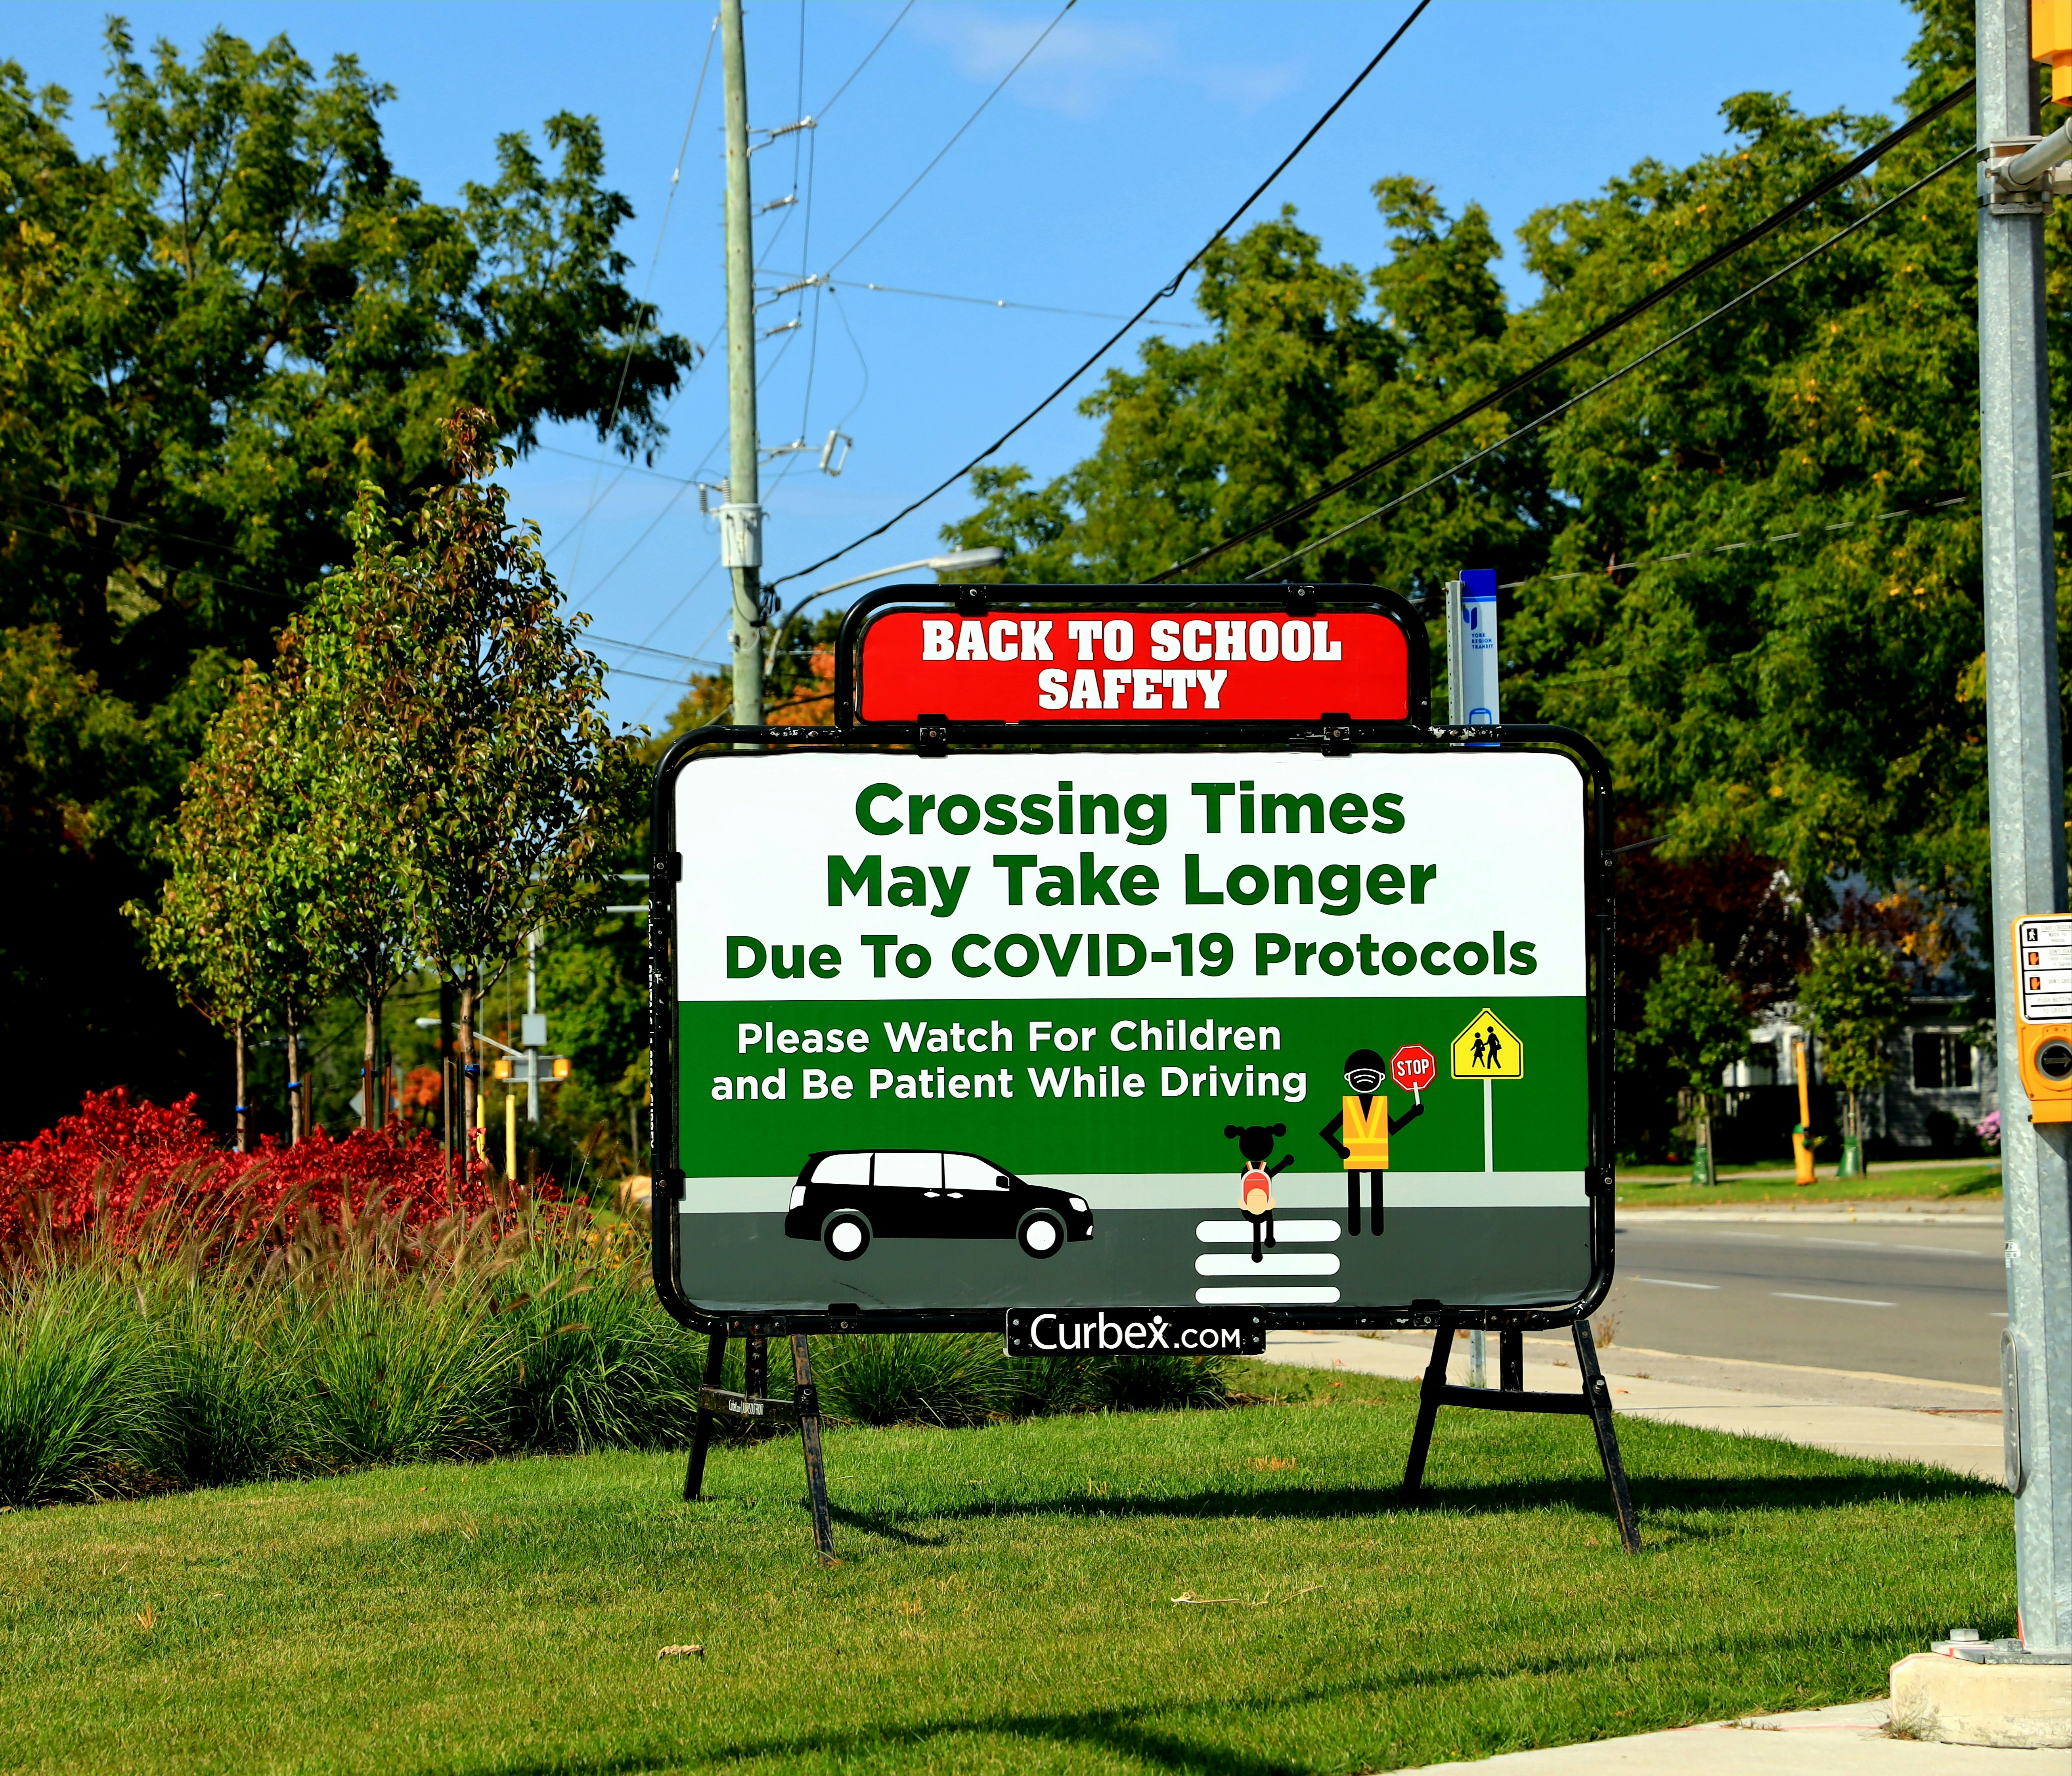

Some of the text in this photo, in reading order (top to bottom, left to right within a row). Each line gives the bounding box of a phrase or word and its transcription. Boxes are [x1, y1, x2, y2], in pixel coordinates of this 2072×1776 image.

[922, 620, 1342, 661] BACK TO SCHOOL
[1038, 668, 1228, 710] SAFETY
[855, 780, 1406, 845] Crossing Times
[827, 852, 1437, 918] May Take Longer
[726, 930, 1537, 979] Due To COVID-19 Protocols
[738, 1019, 1280, 1053] Please Watch For Children
[711, 1065, 1307, 1103] and Be Patient While Driving
[1397, 1059, 1429, 1076] STOP
